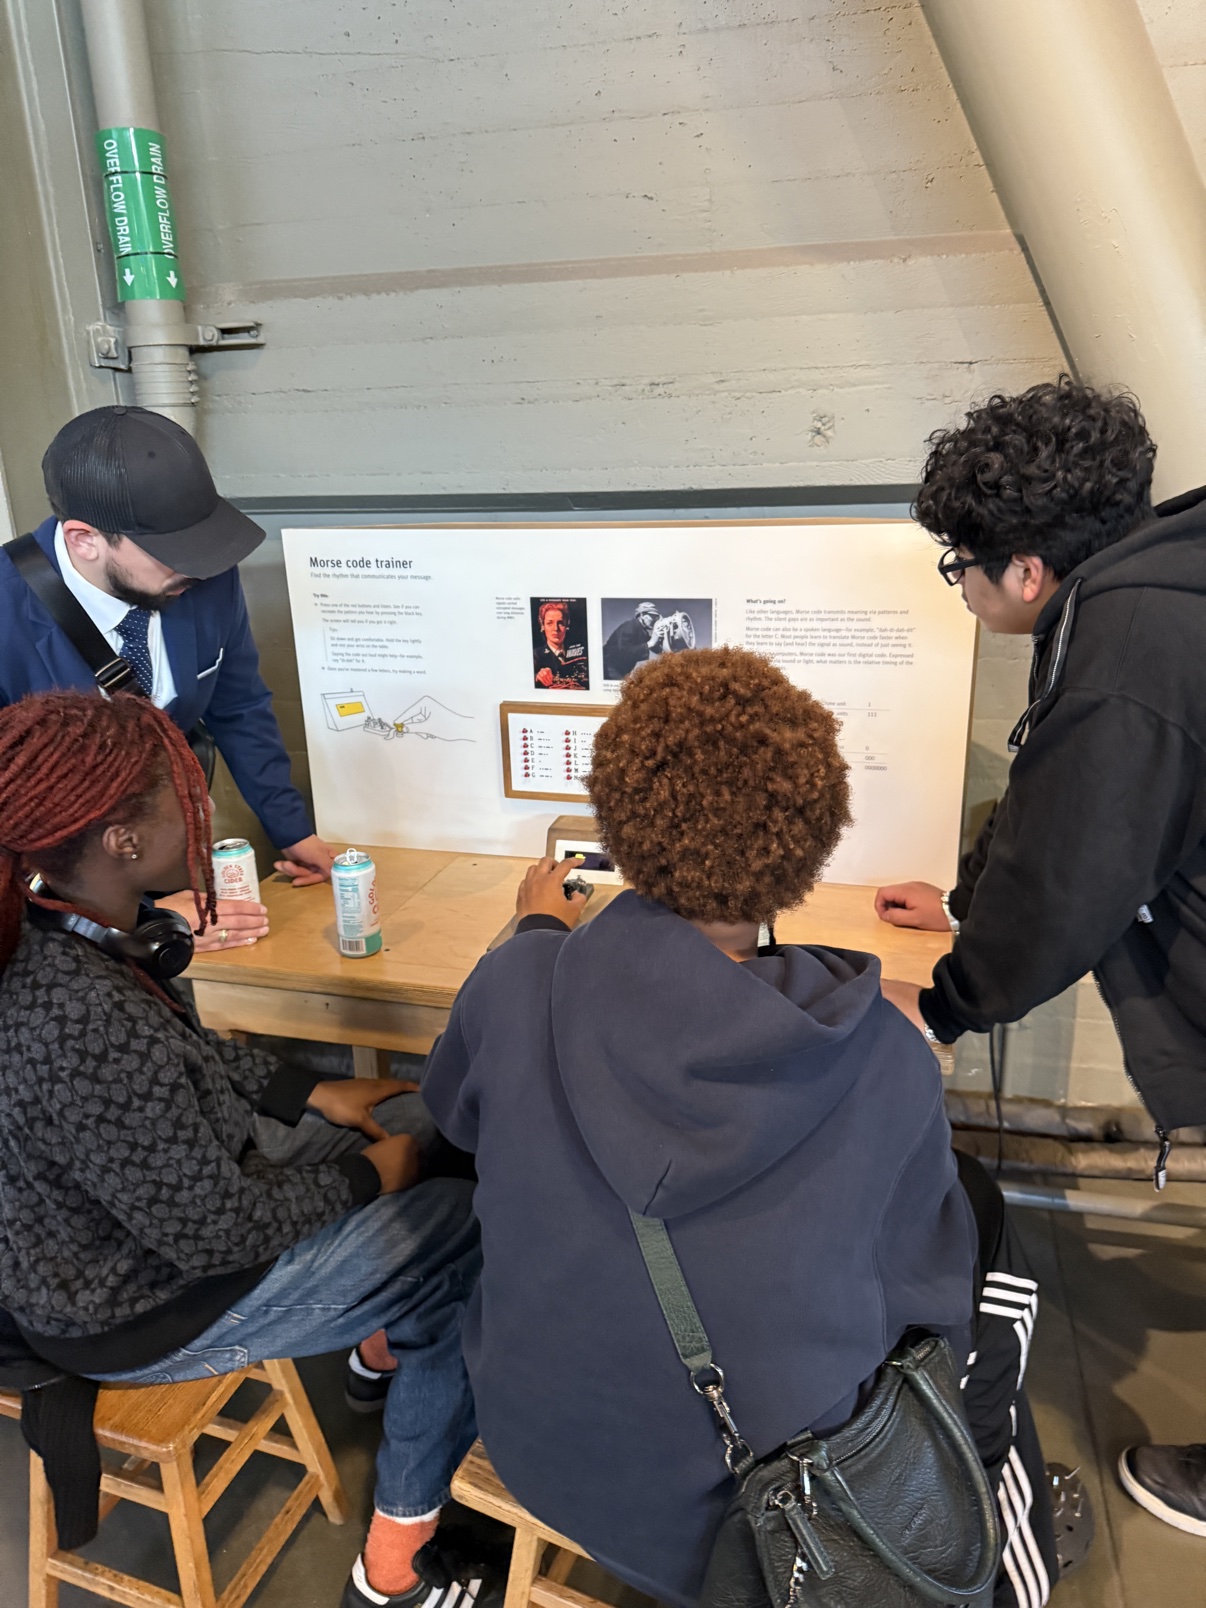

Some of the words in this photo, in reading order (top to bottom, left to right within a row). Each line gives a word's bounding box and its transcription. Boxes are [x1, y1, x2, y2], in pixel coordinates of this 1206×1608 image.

[148, 142, 166, 184] DRAIN
[155, 186, 174, 259] OVERFLOW
[310, 556, 342, 568] Morse
[346, 558, 372, 568] code
[376, 557, 413, 569] trainer
